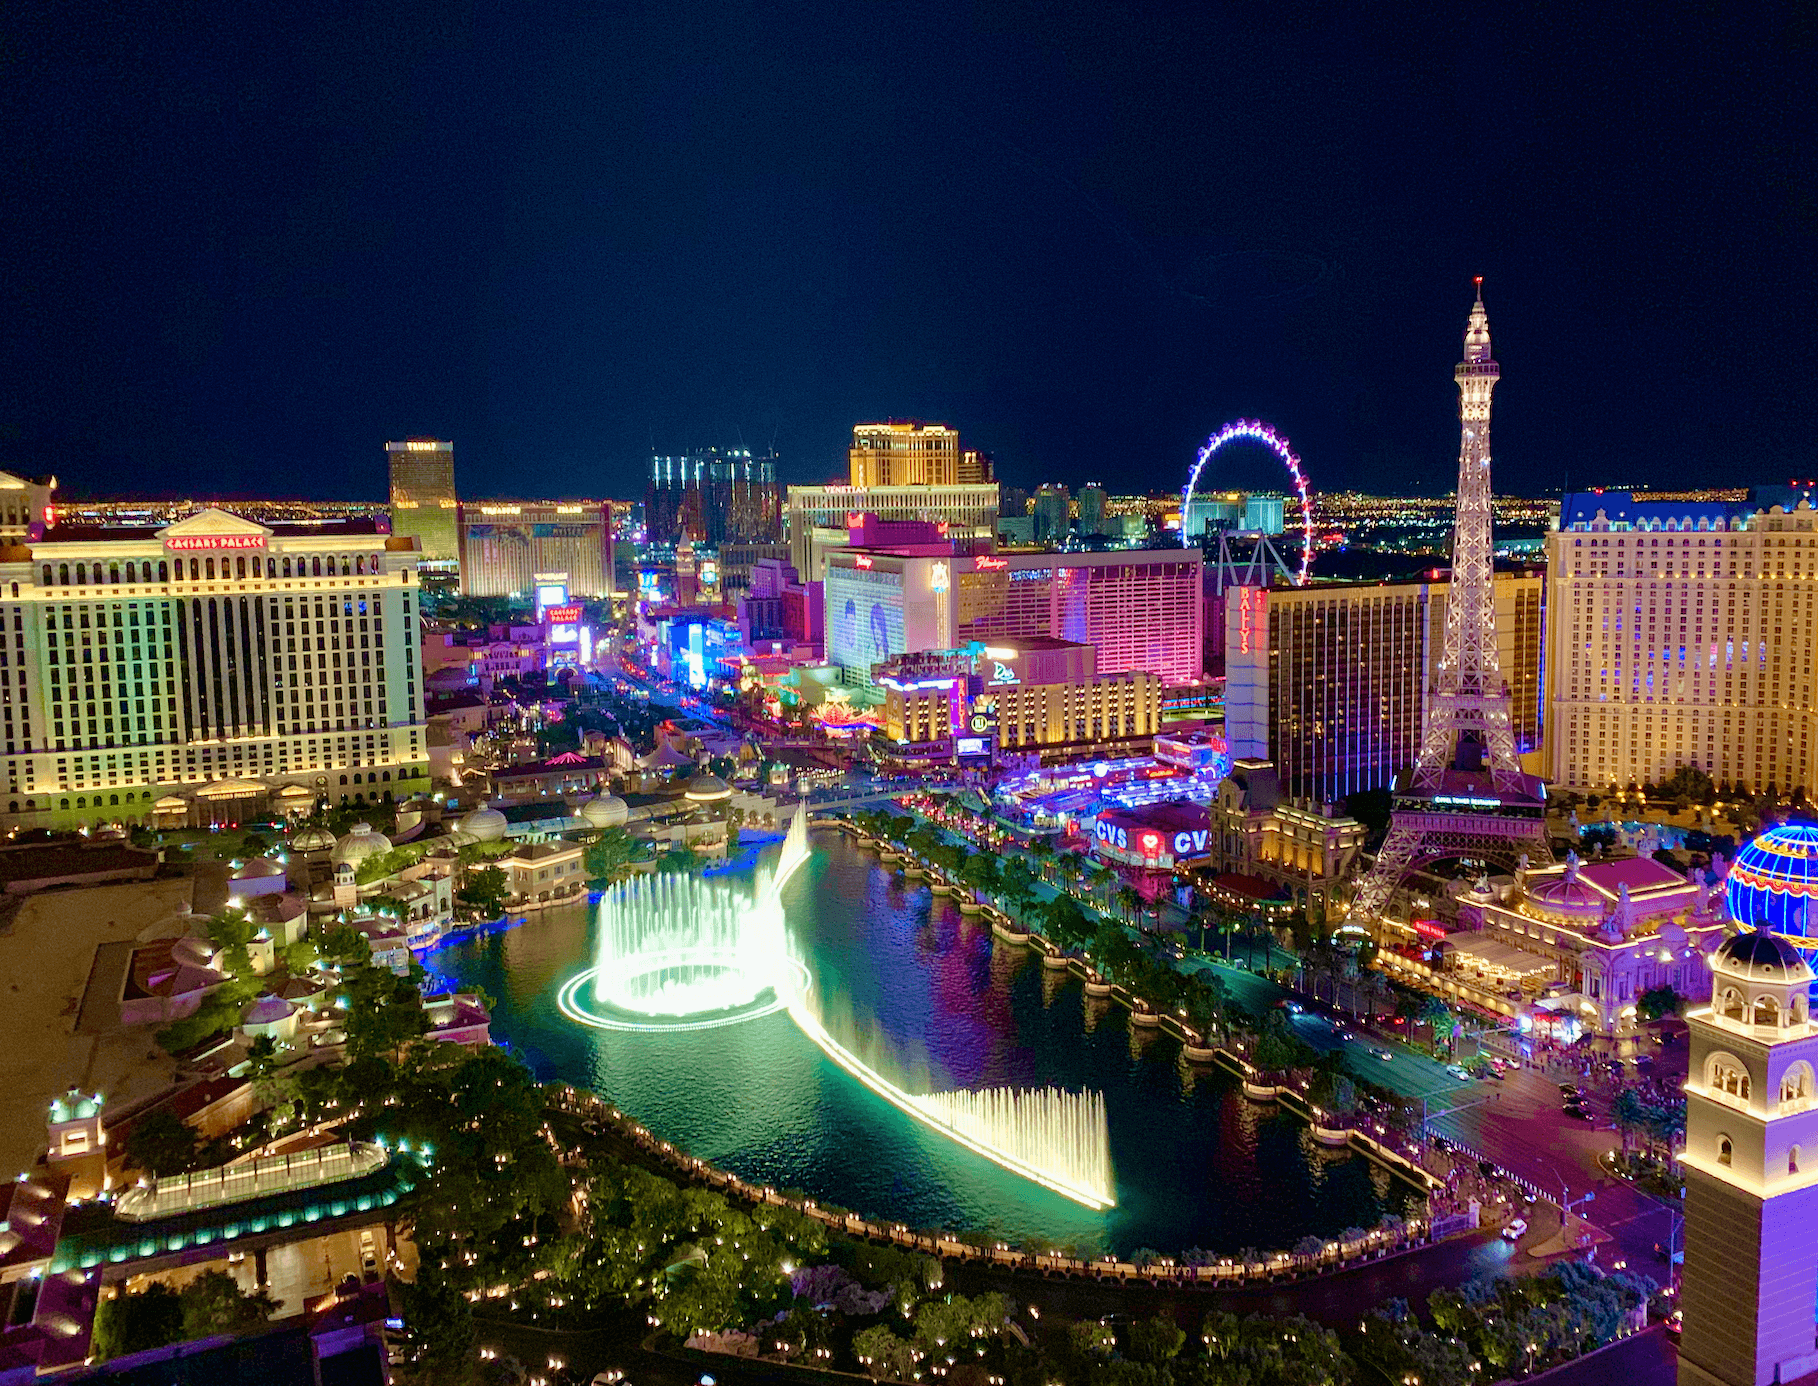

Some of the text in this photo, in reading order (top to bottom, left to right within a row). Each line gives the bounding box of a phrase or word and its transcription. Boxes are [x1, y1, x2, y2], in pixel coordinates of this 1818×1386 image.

[407, 442, 436, 451] TRUMP
[824, 486, 868, 494] VENETIAN
[167, 537, 264, 549] CAESARS PALACE
[1096, 820, 1128, 849] CVS
[1173, 829, 1213, 853] CV
